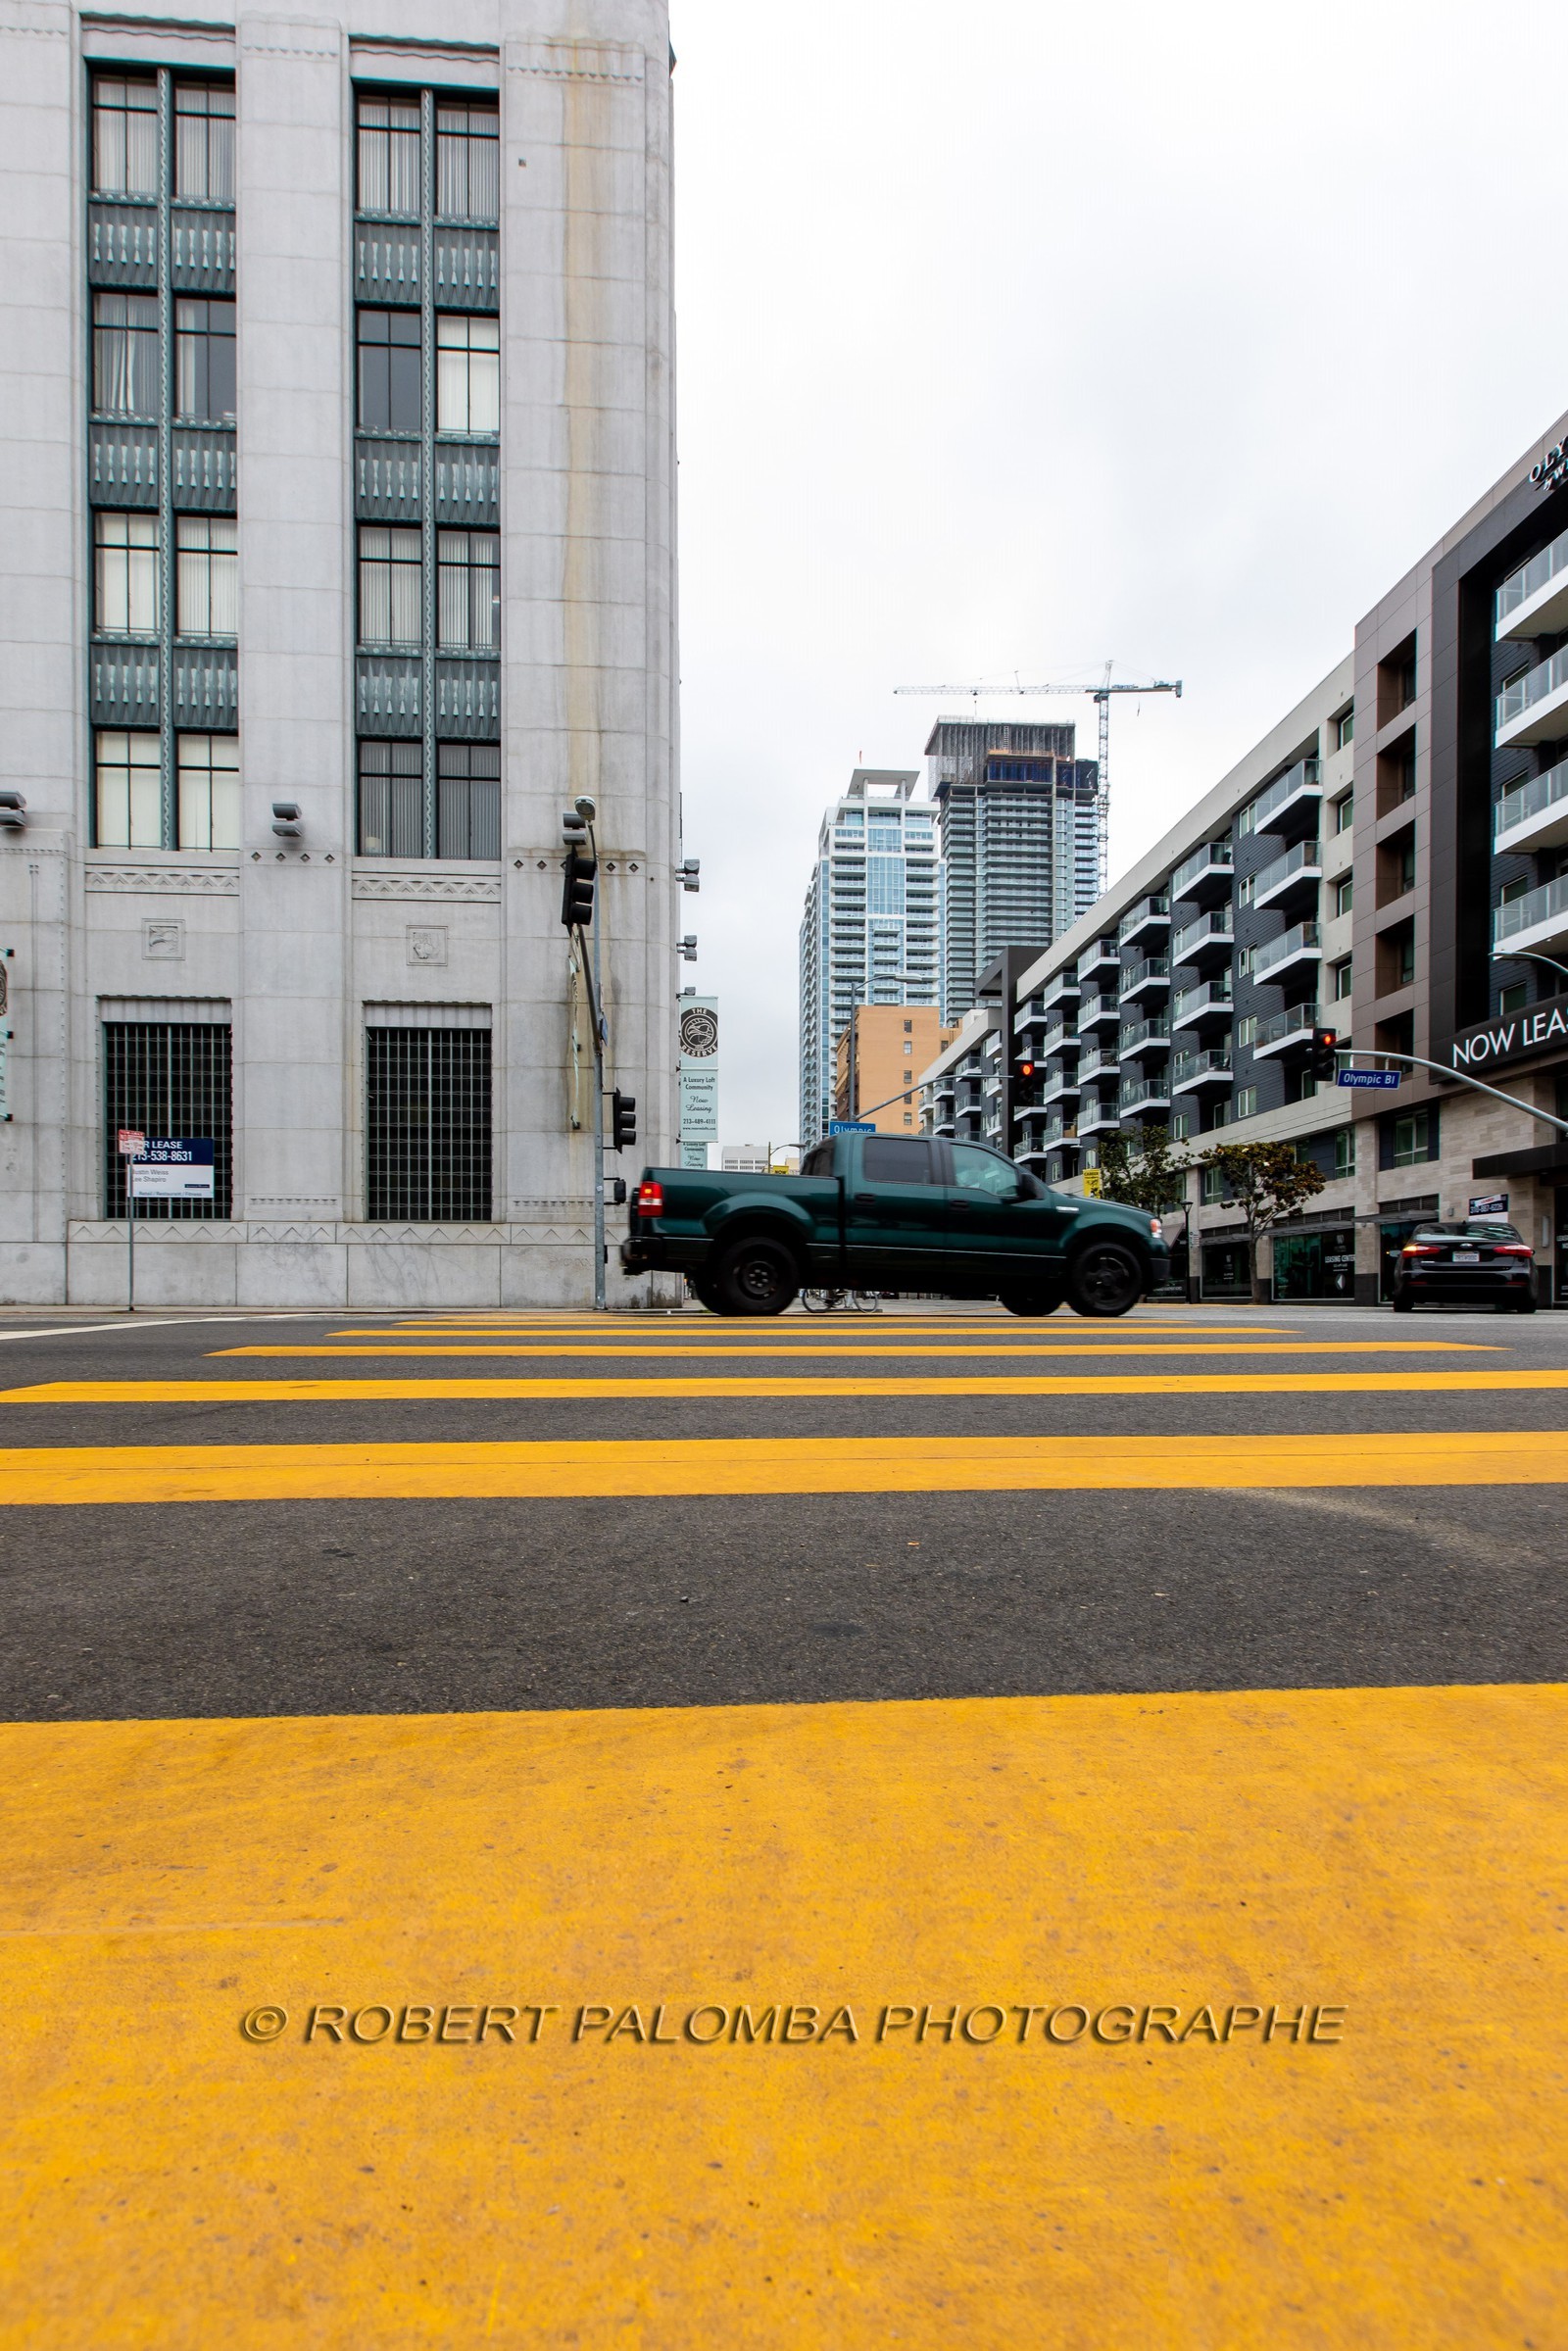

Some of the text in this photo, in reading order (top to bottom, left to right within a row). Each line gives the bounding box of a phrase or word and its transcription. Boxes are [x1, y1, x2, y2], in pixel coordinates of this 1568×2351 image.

[1452, 1007, 1568, 1068] NOW LEA
[680, 1044, 717, 1057] RESERVE
[1344, 1073, 1396, 1085] Olympic Bl
[690, 1095, 709, 1103] Now
[685, 1103, 712, 1113] Leasing
